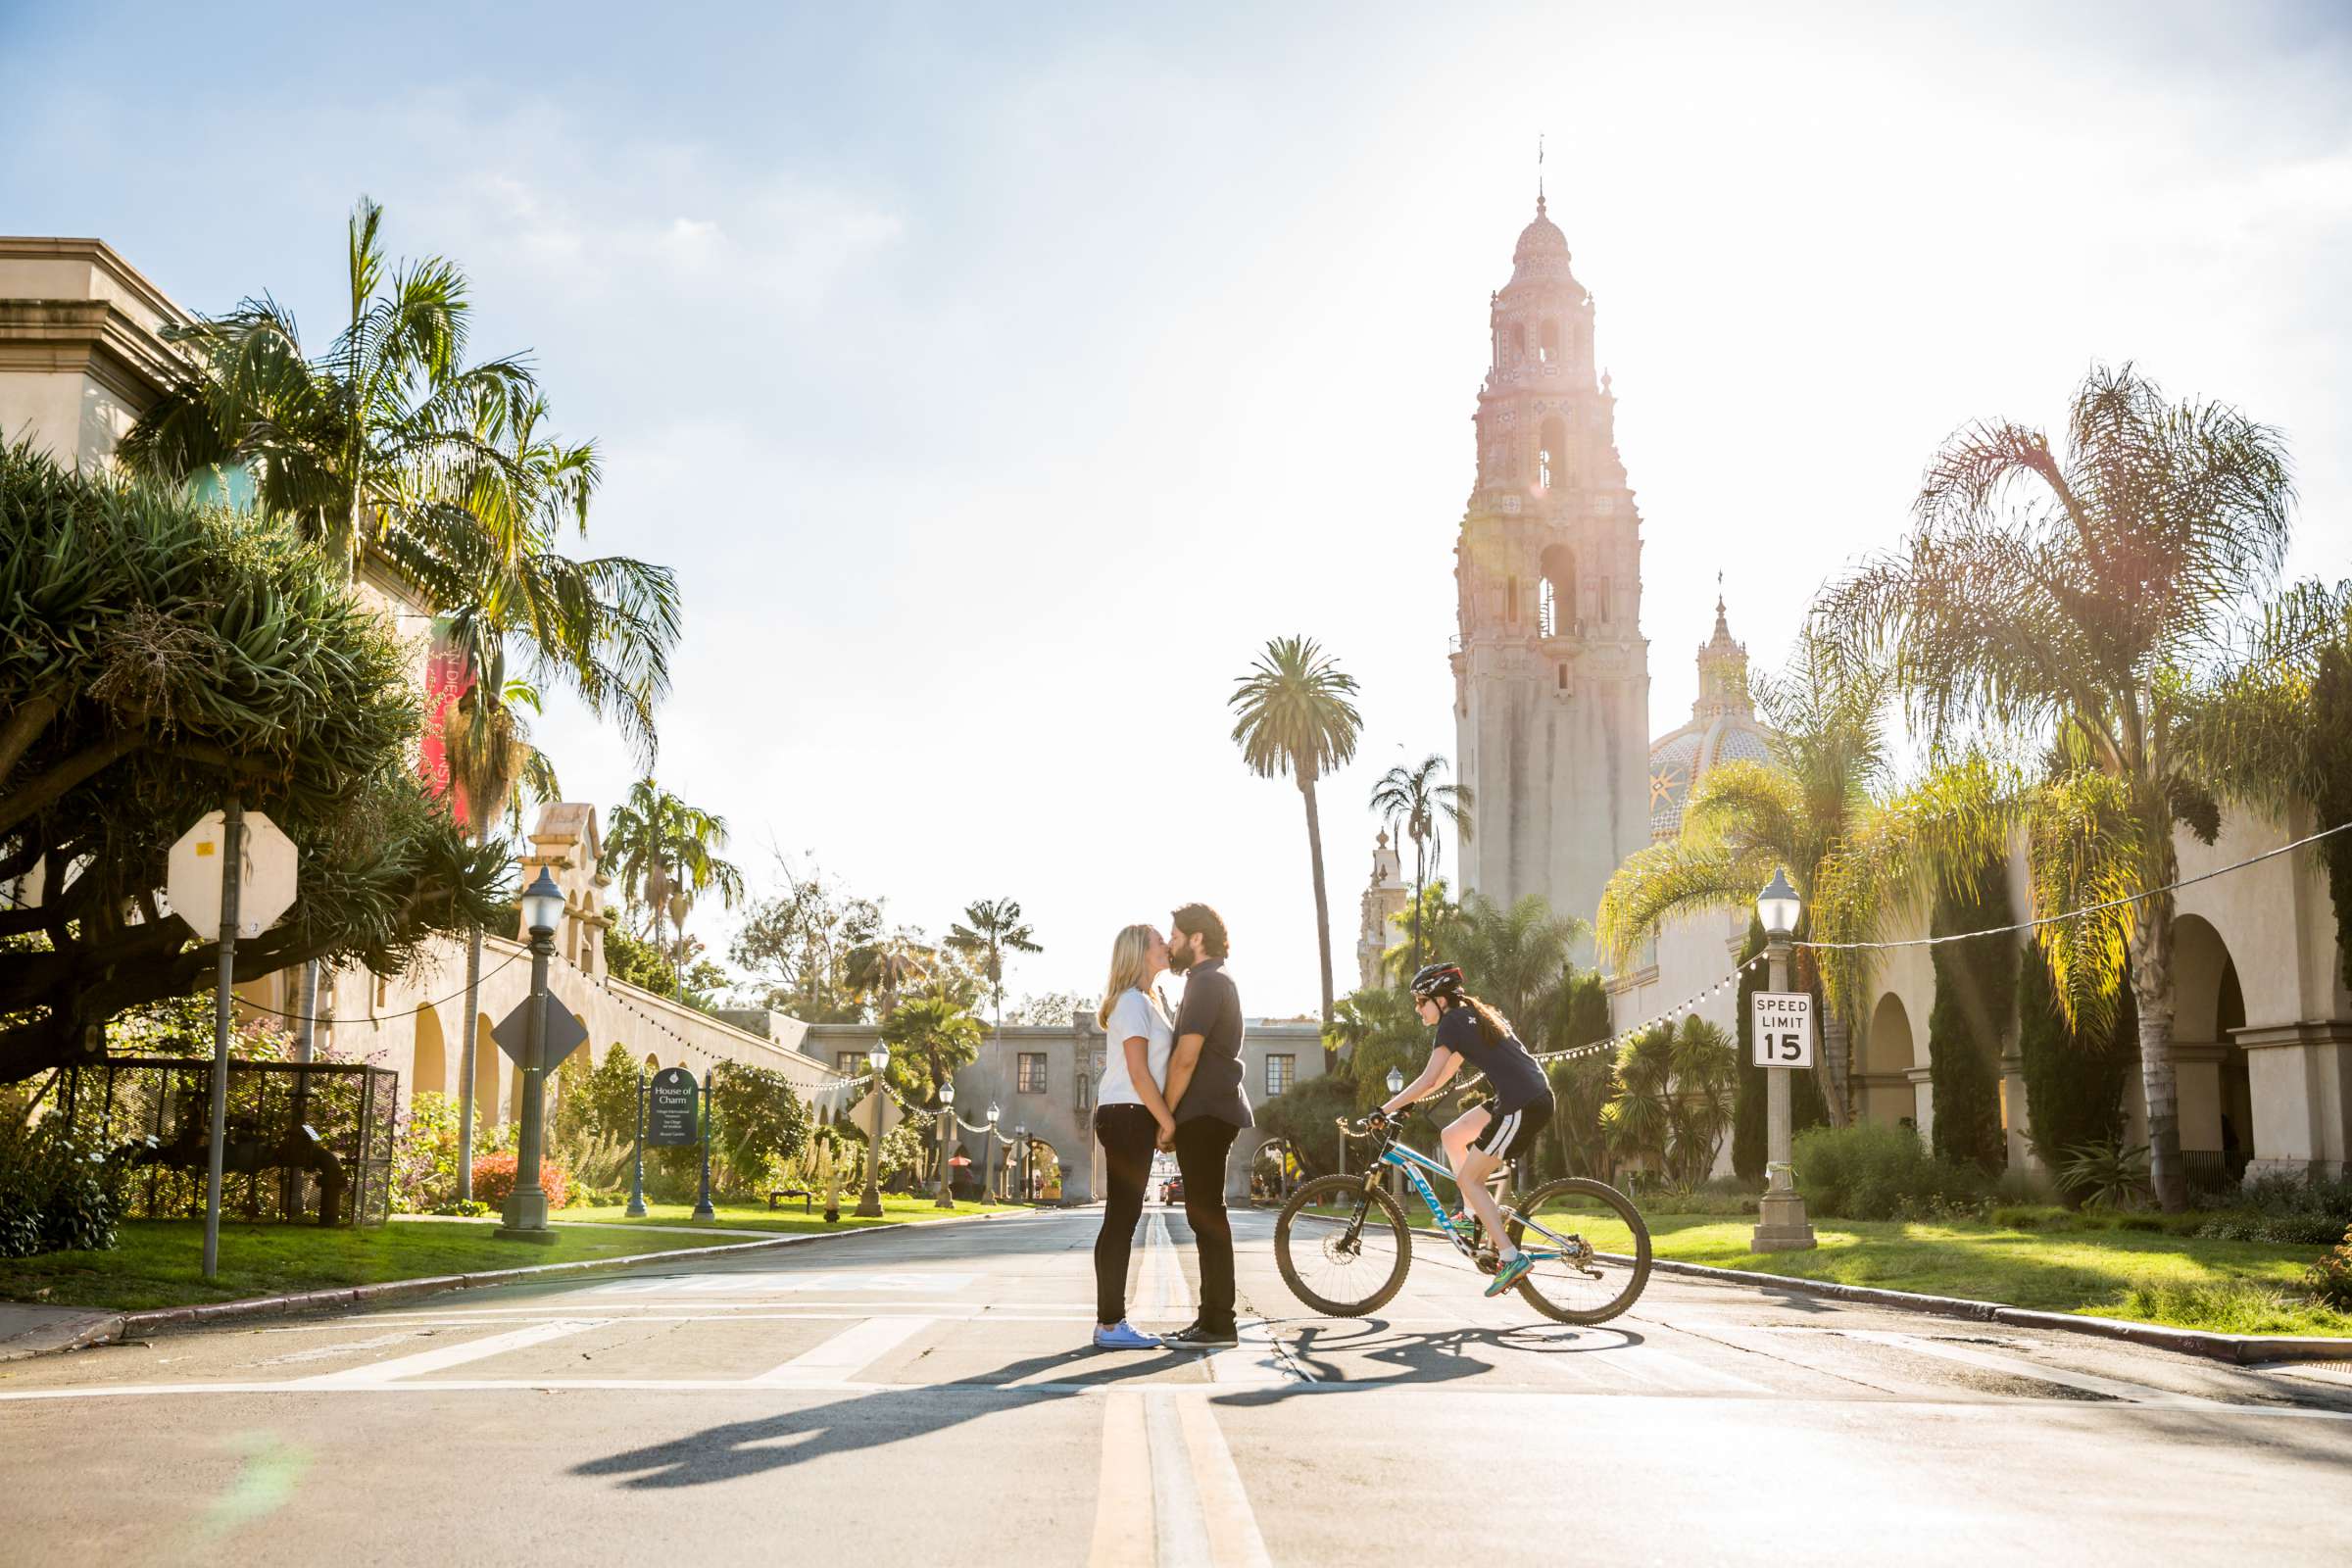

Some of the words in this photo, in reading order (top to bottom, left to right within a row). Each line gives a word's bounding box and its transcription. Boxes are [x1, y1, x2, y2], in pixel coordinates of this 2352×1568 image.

[1757, 1000, 1807, 1011] SPEED
[1762, 1016, 1804, 1028] LIMIT
[1764, 1033, 1801, 1060] 15
[655, 1087, 682, 1096] House
[682, 1086, 692, 1096] of
[659, 1096, 687, 1104] Charm
[1417, 1177, 1456, 1231] GIANT
